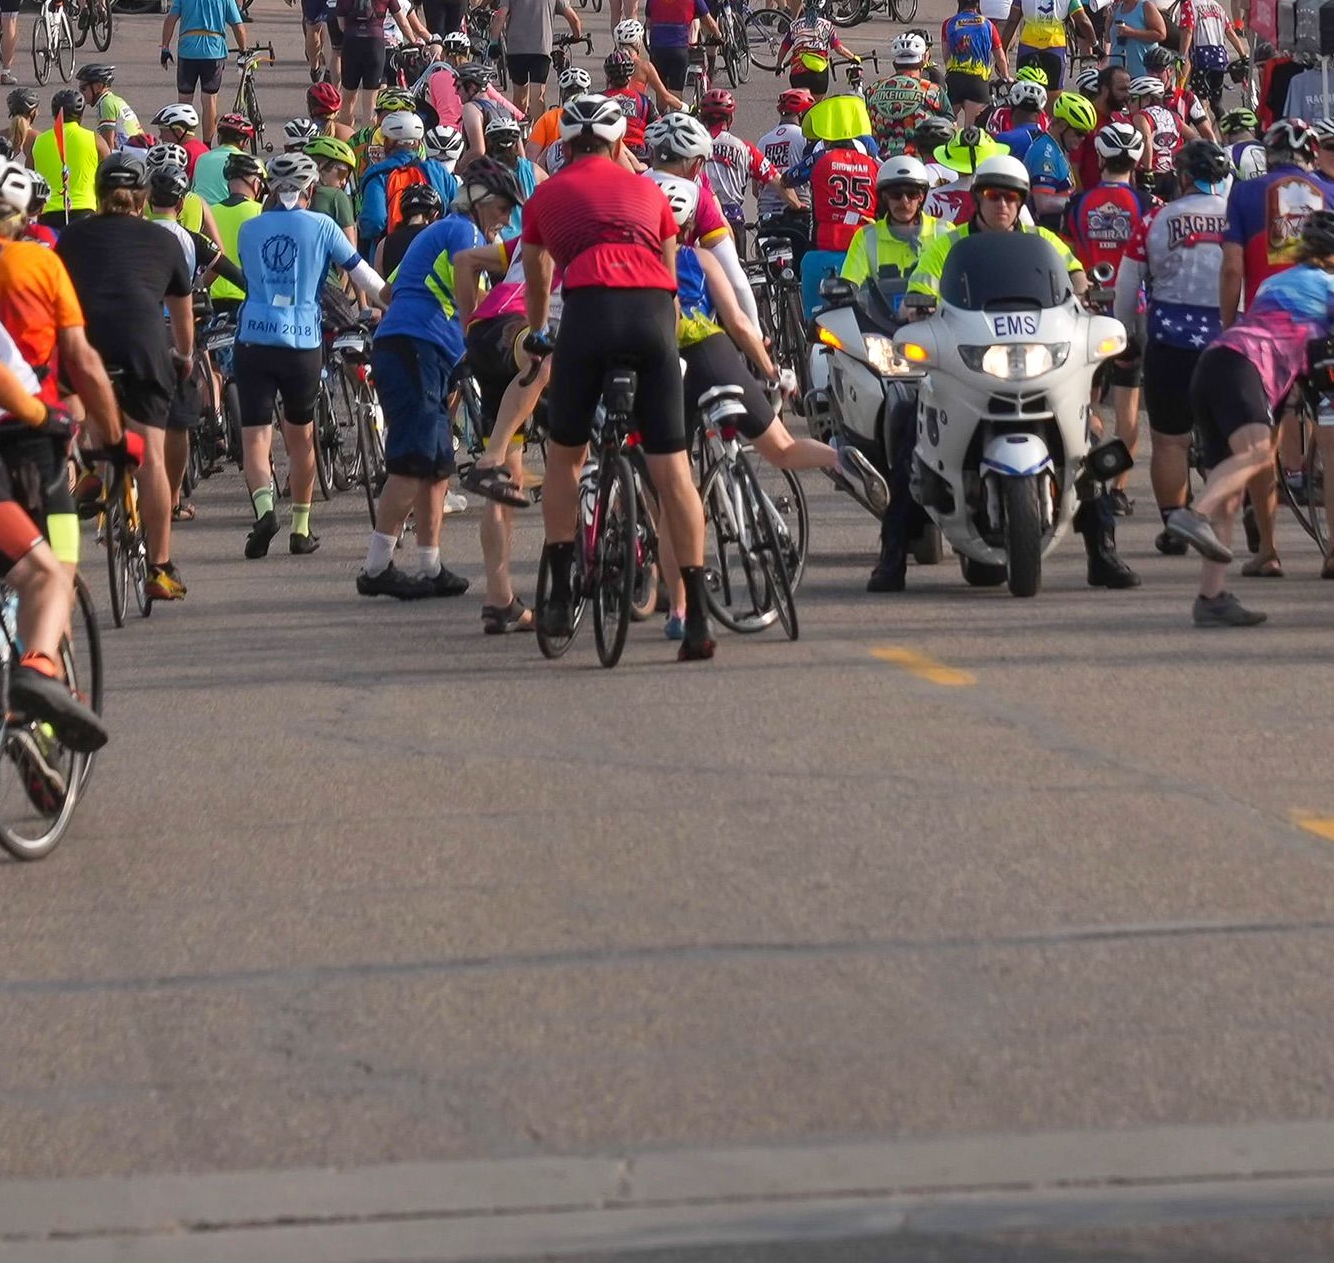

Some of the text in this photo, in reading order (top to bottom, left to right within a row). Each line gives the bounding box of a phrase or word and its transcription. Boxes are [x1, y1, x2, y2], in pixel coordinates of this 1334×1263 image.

[765, 145, 789, 157] RIDE
[831, 162, 869, 173] SHOWMAN
[827, 175, 872, 211] 35
[248, 320, 312, 337] RAIN 2018
[994, 315, 1036, 337] EMS
